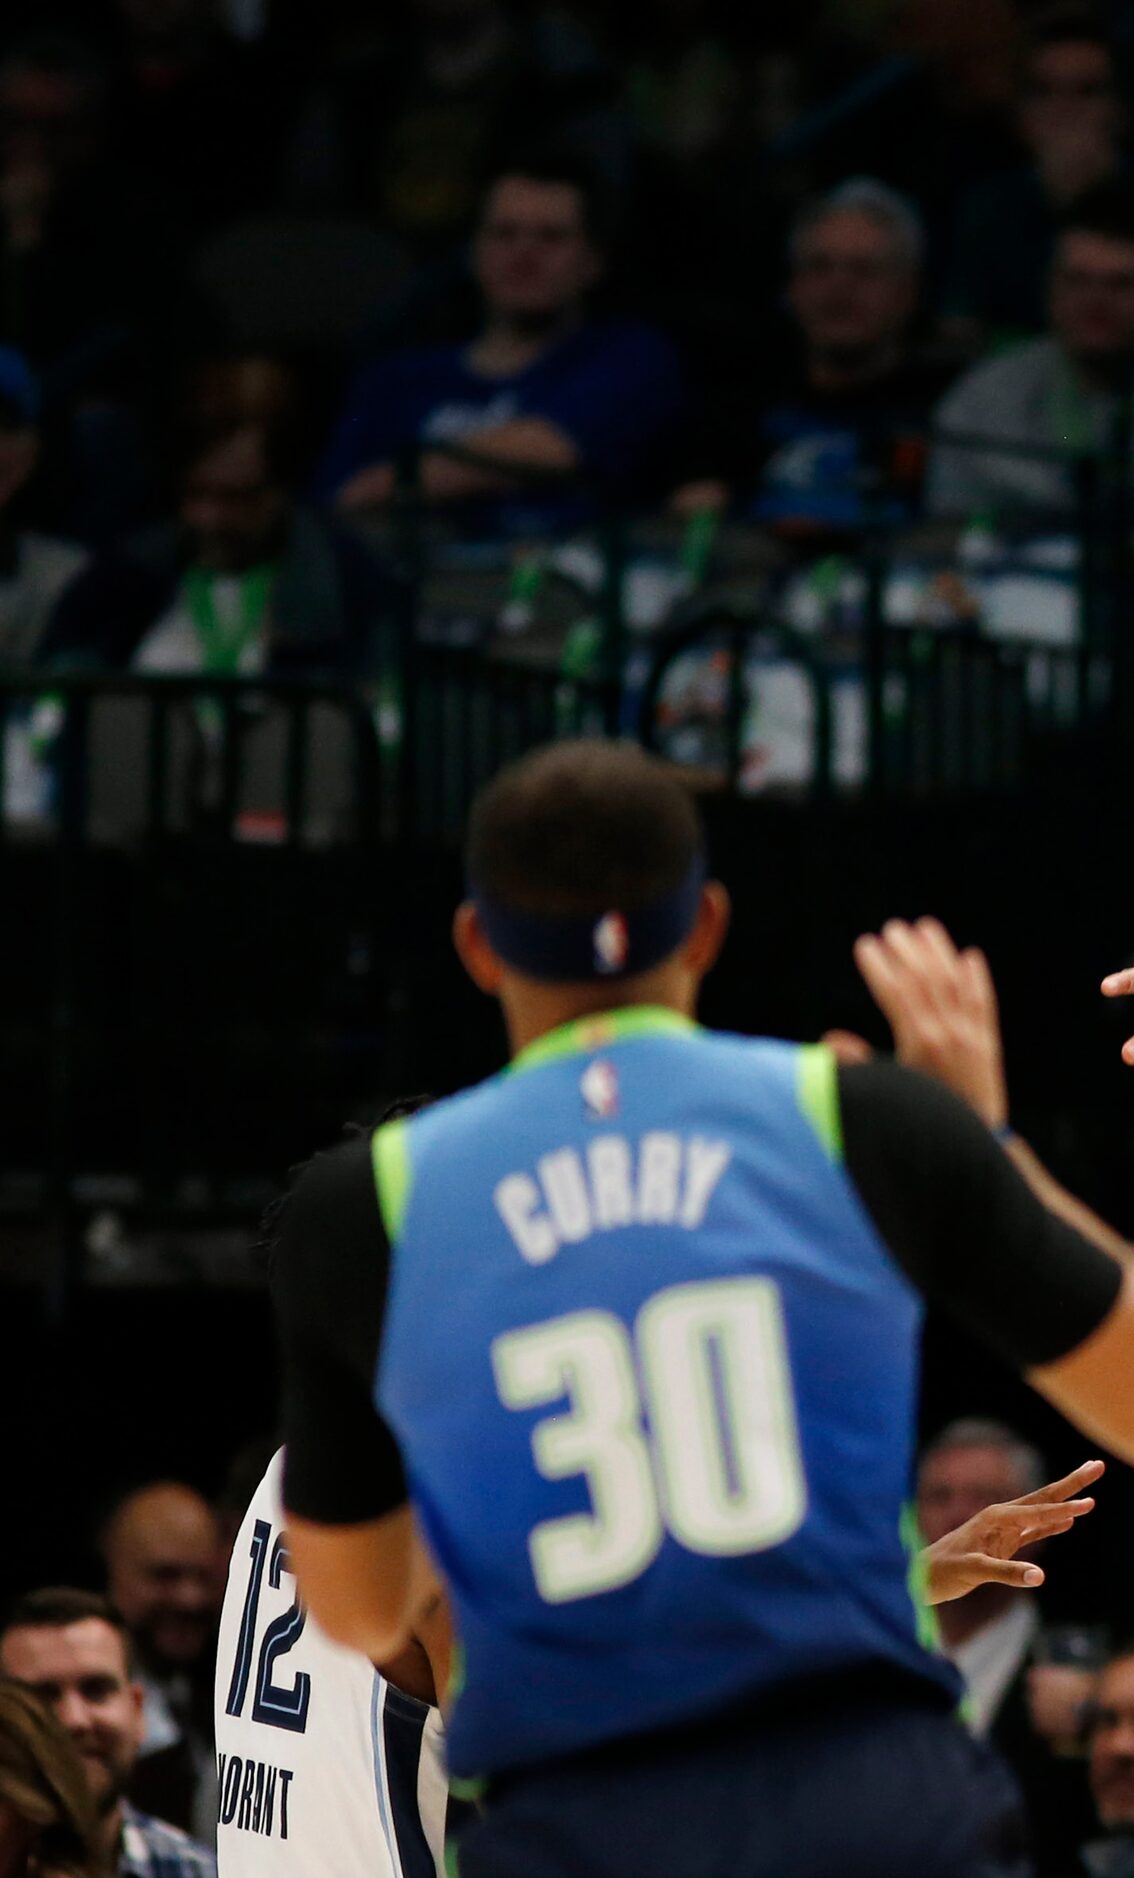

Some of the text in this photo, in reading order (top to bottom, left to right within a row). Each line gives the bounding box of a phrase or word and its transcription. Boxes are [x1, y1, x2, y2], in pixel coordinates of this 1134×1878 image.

[493, 1131, 732, 1266] CURRY
[491, 1274, 807, 1604] 30
[225, 1519, 311, 1733] 12
